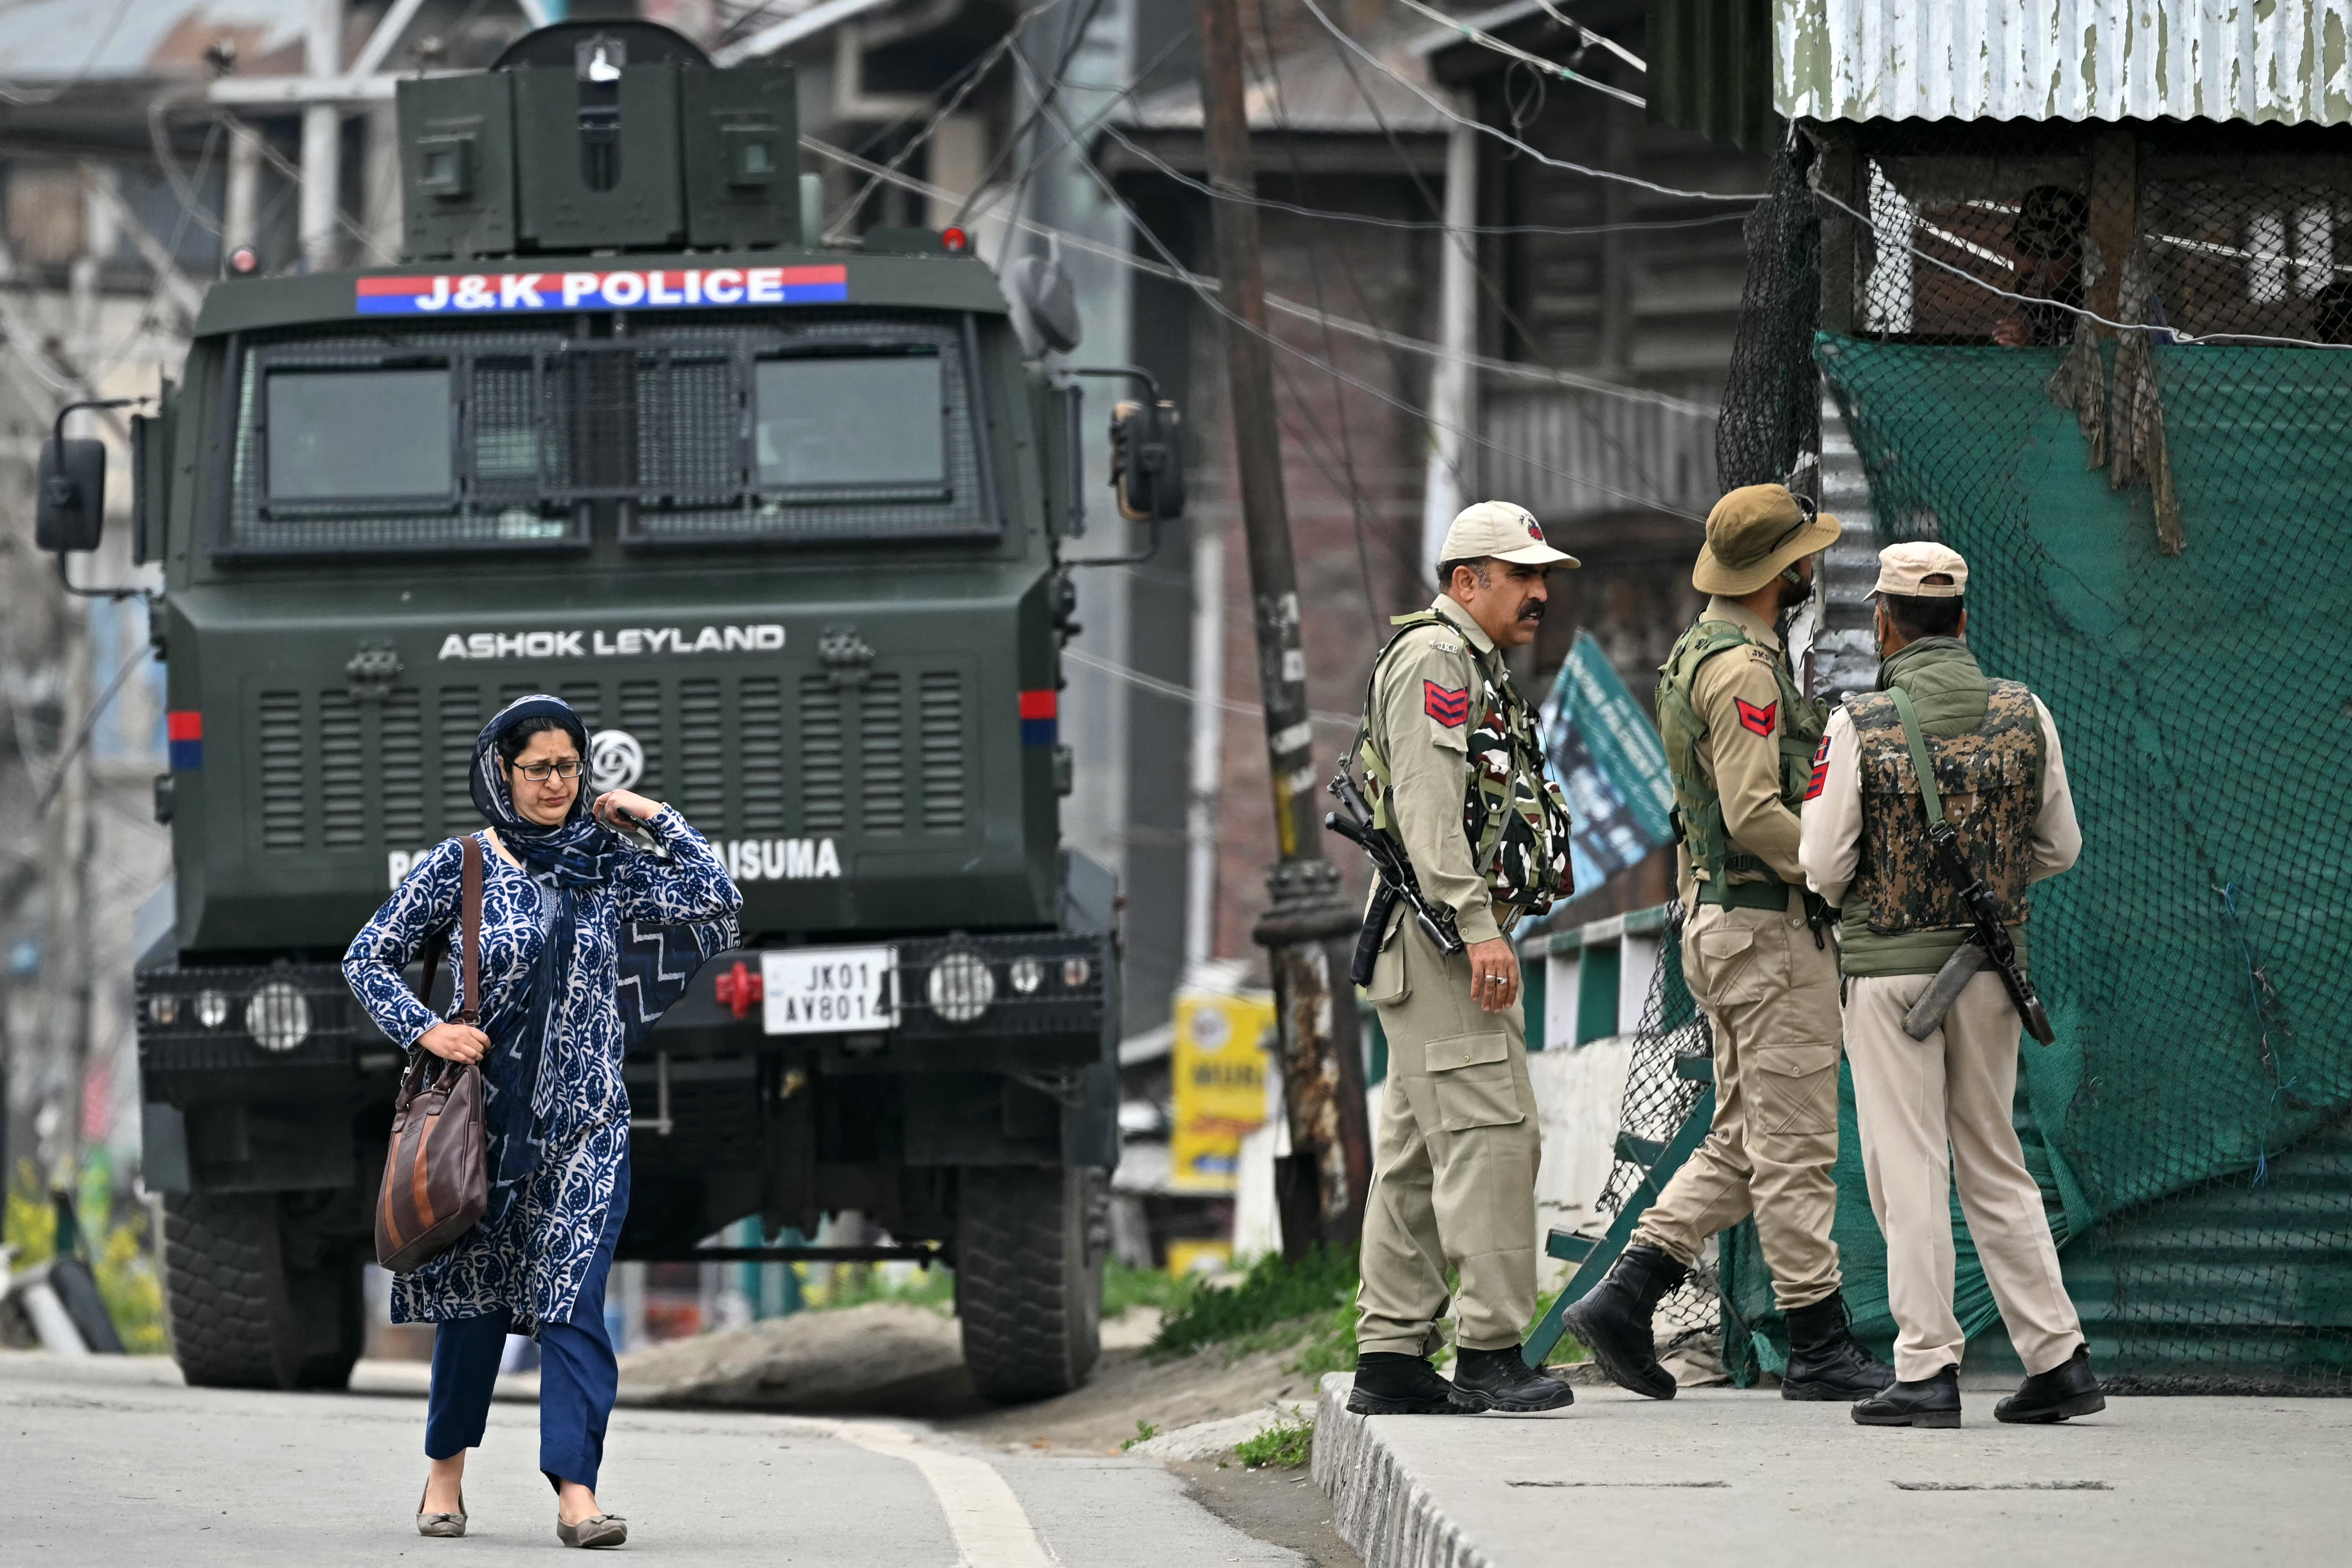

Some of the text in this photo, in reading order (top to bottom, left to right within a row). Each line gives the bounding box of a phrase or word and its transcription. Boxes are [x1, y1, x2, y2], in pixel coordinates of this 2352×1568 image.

[414, 267, 785, 311] J&K POLICE
[438, 624, 786, 660] ASHOK LEYLAND
[805, 963, 868, 992] JK01
